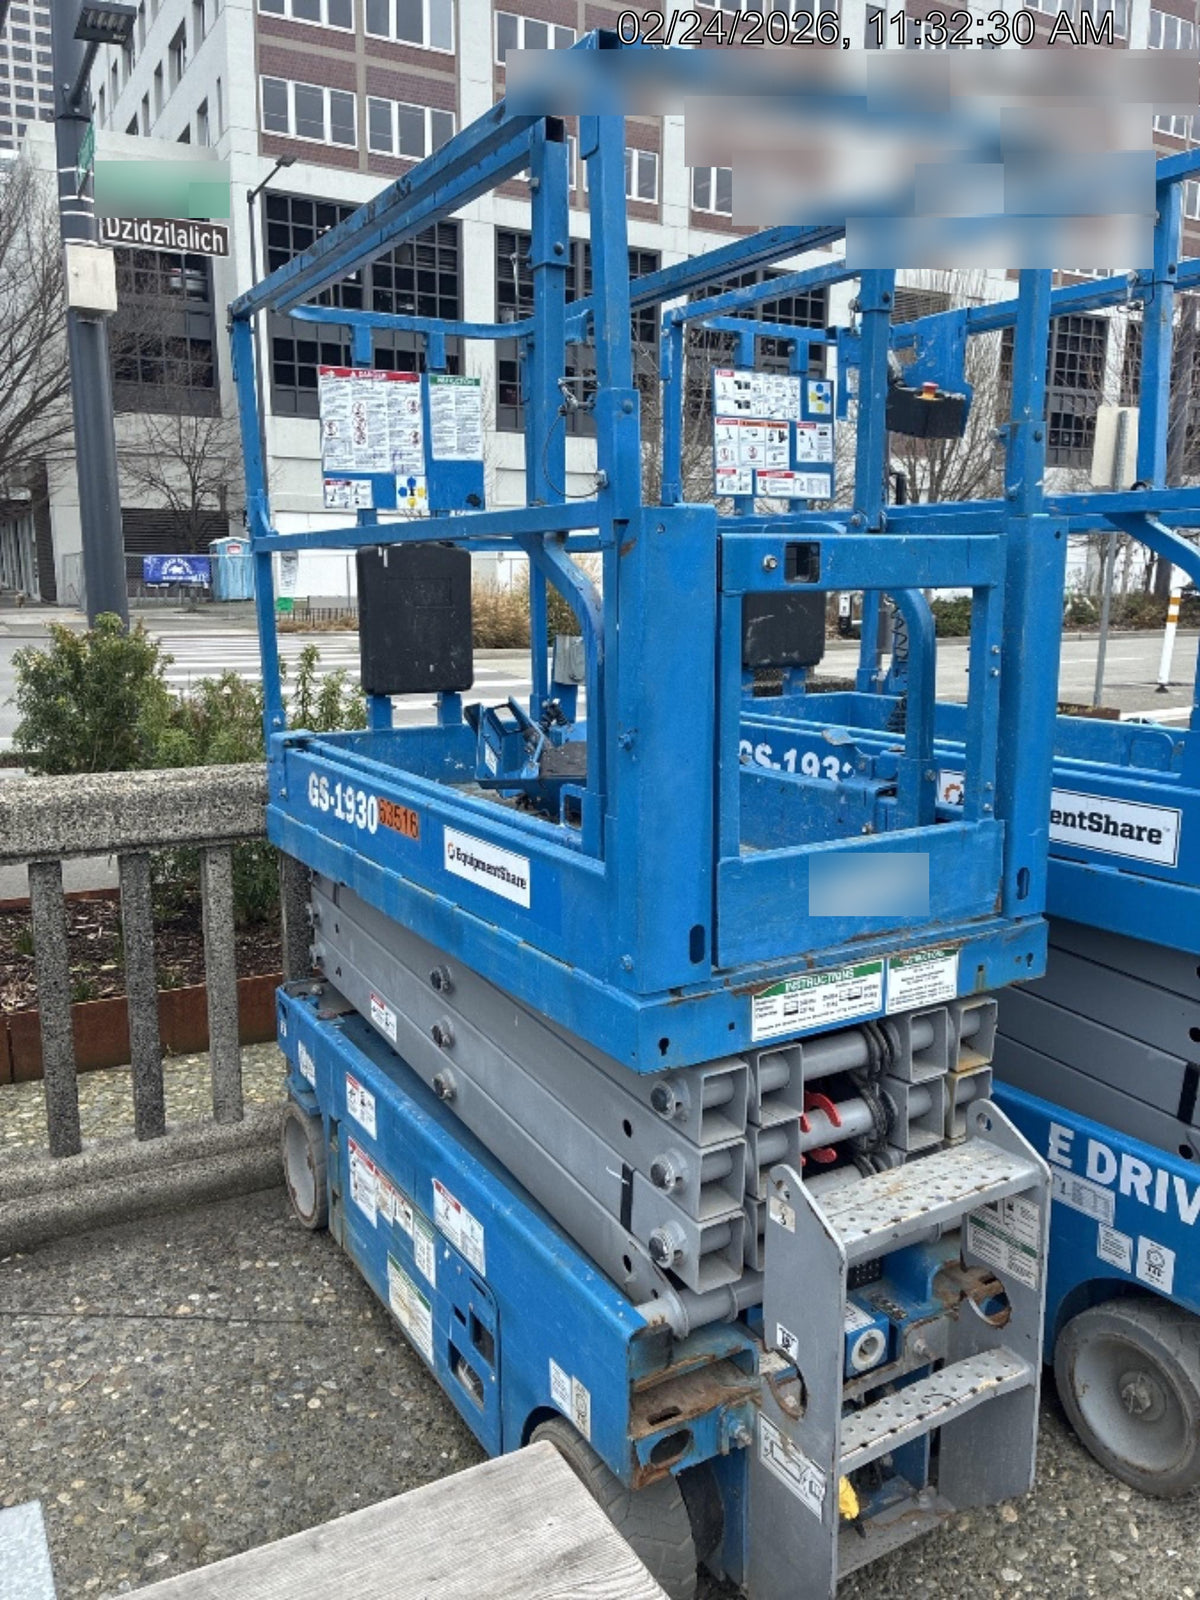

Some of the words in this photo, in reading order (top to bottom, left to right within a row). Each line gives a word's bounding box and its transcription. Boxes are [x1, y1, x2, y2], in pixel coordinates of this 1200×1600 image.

[106, 218, 224, 253] Dzidzilalich
[739, 739, 855, 783] GS-193
[308, 771, 378, 834] GS-1930
[456, 846, 527, 890] EquipmentShare
